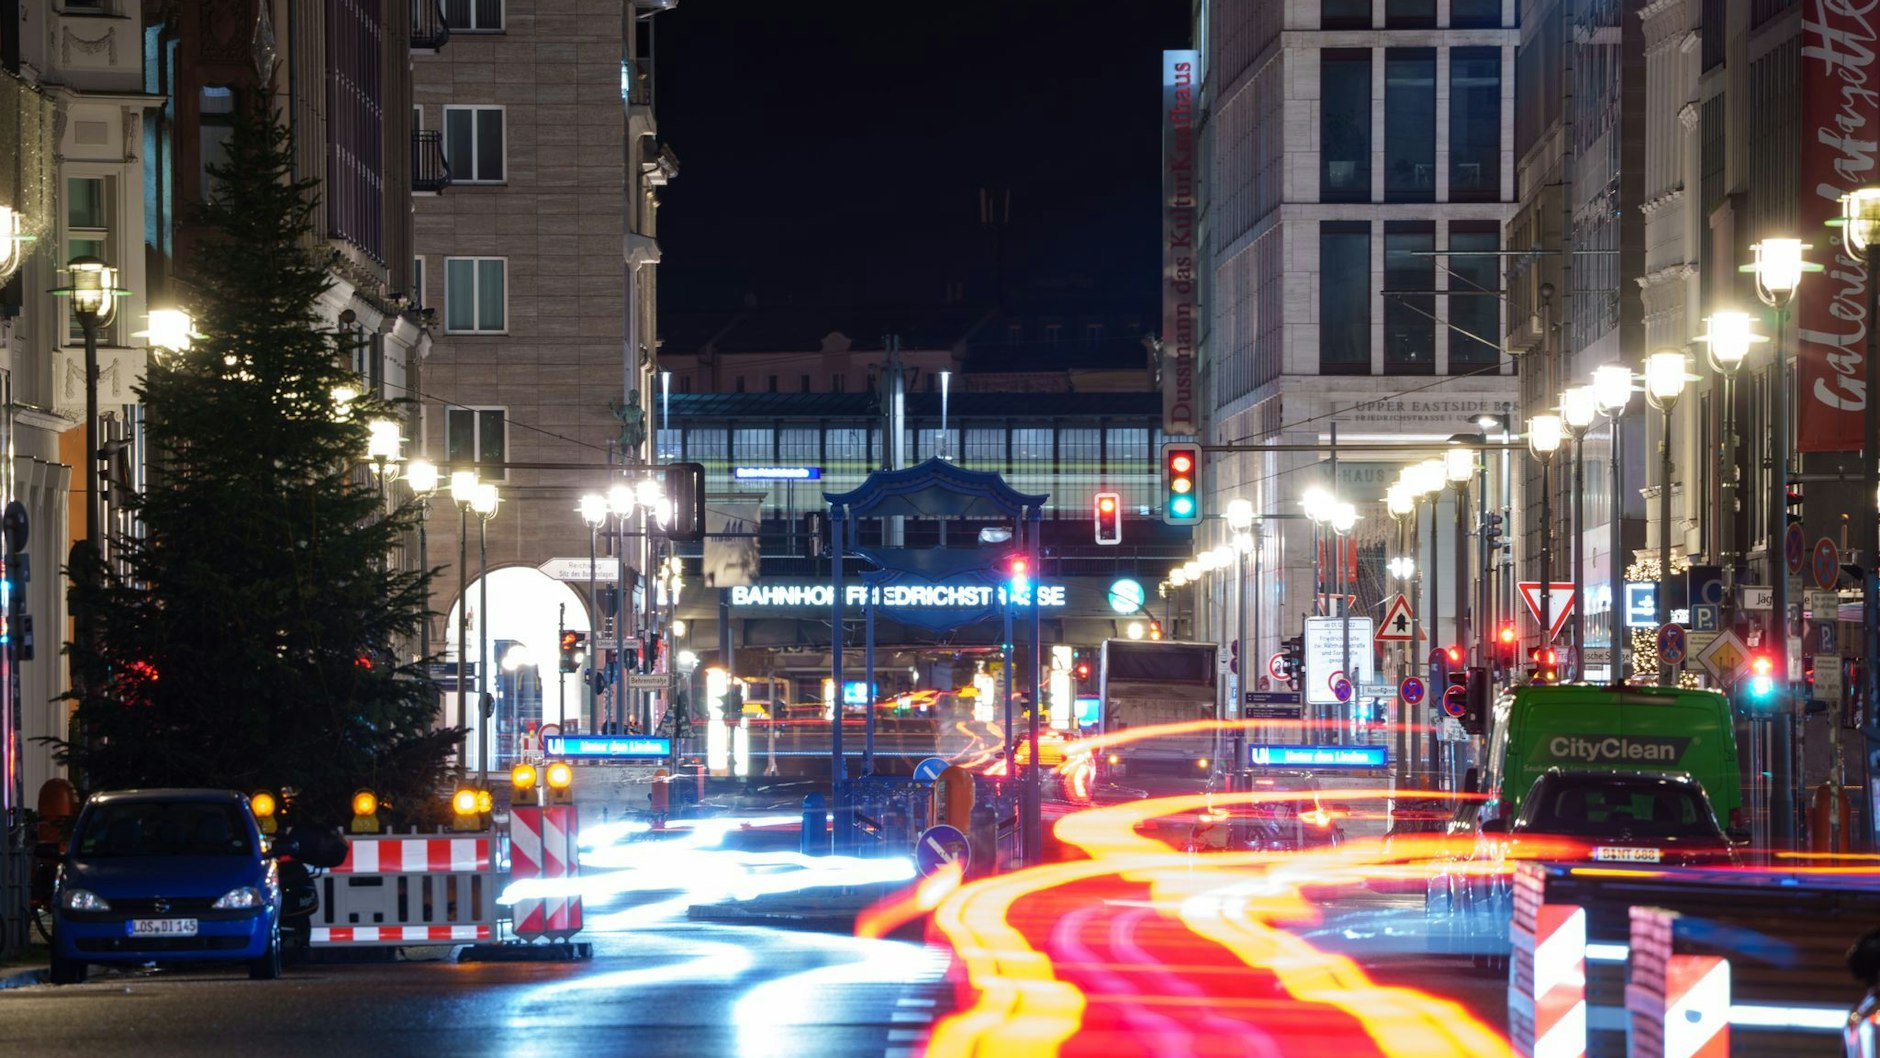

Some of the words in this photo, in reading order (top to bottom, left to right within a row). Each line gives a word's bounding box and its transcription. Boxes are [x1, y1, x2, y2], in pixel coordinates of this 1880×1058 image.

[1168, 62, 1192, 251] KulturKaufhaus
[1171, 257, 1191, 294] das
[1799, 234, 1868, 411] Galerie
[1171, 303, 1192, 424] Dussmann
[1355, 401, 1404, 411] UPPER
[1412, 401, 1488, 412] EASTSIDE
[631, 677, 667, 685] Behrenstraße
[581, 741, 607, 752] Unter
[609, 741, 628, 753] den
[629, 741, 663, 753] Linden
[1550, 736, 1676, 762] CityClean
[1285, 751, 1312, 763] Unter
[1314, 751, 1334, 763] den
[1335, 751, 1369, 763] Linden
[177, 919, 196, 932] 145
